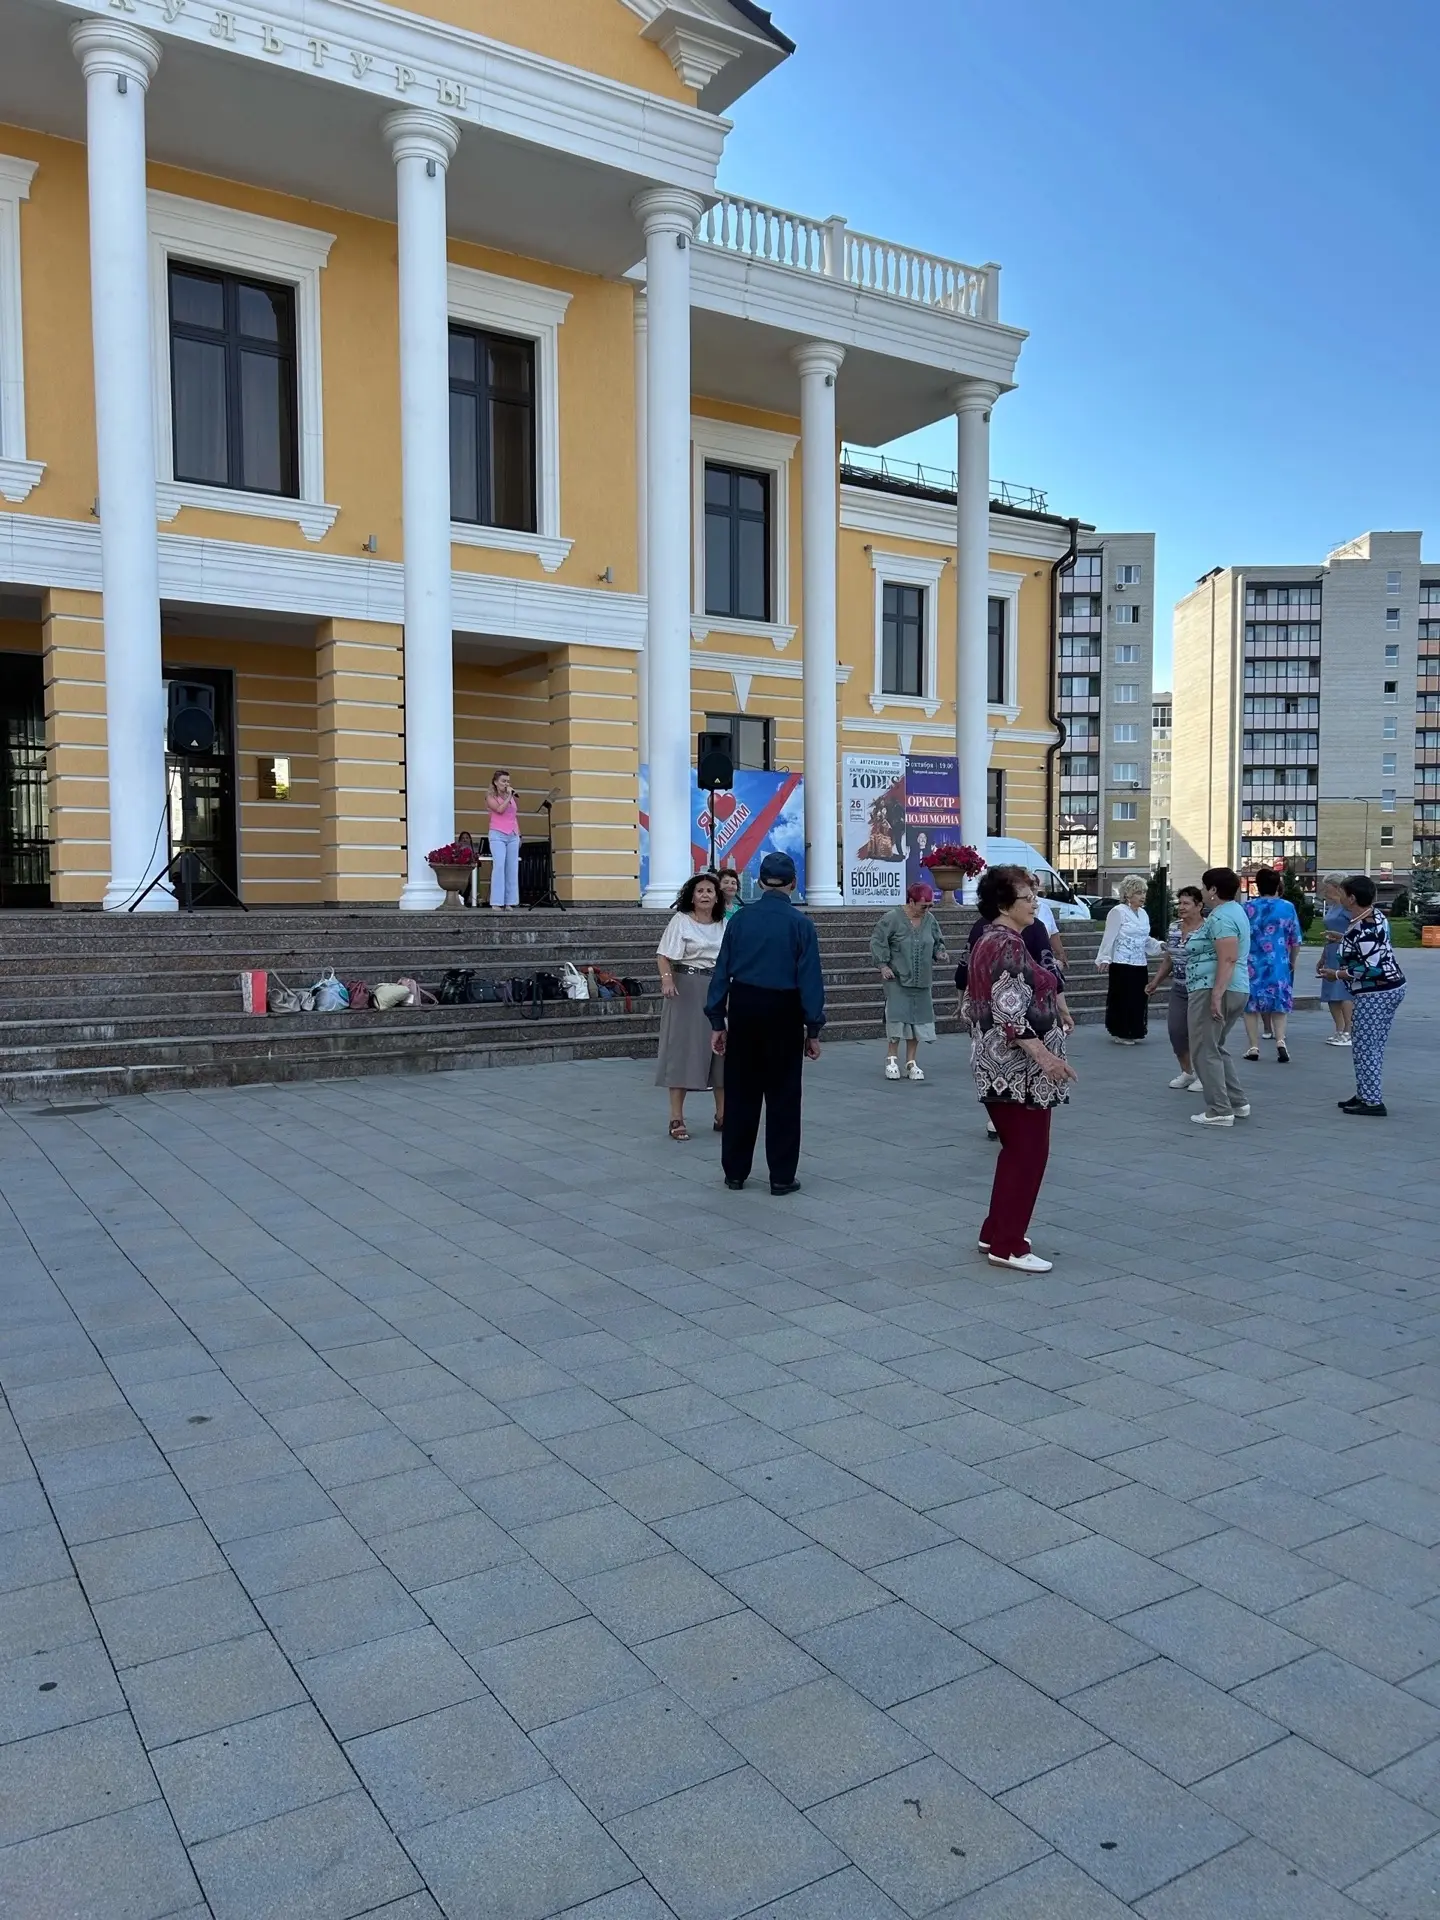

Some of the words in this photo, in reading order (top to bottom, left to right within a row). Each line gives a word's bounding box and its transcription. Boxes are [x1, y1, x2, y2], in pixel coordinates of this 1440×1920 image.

[850, 800, 861, 808] 26
[907, 795, 955, 808] ОРКЕСТР
[697, 810, 716, 838] Я
[714, 803, 750, 849] ИШИМ
[905, 813, 929, 823] ПОЛЯ
[930, 814, 959, 825] МОРИА
[851, 872, 900, 887] БОЛЬШОЕ
